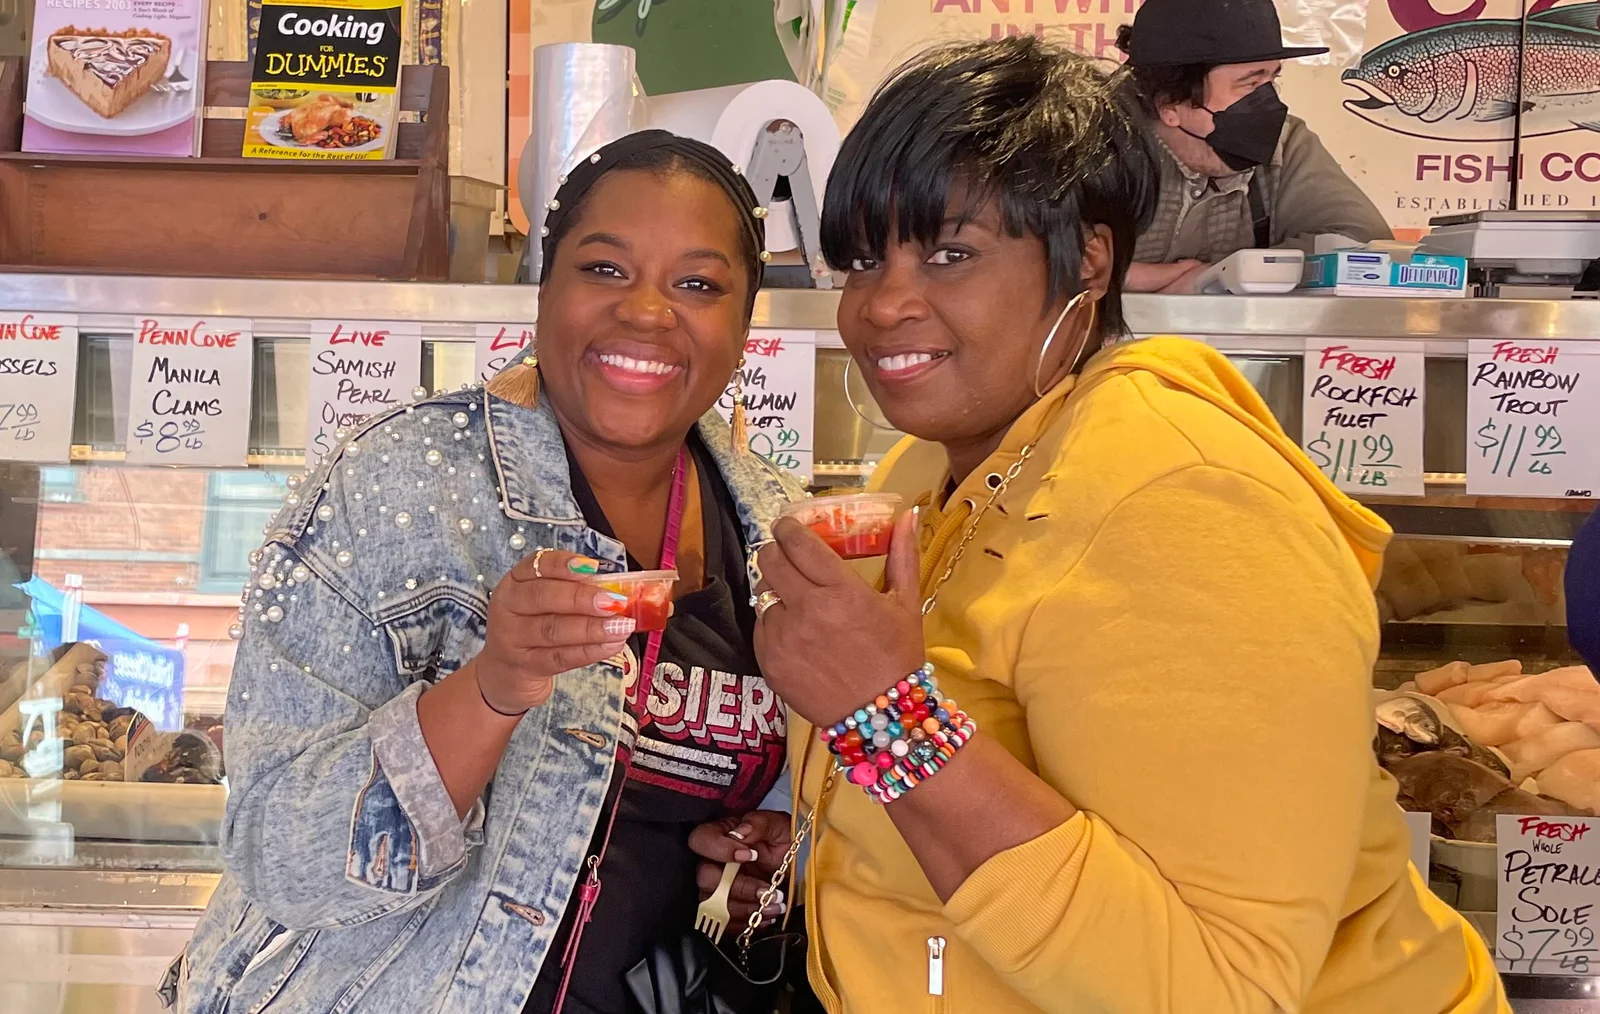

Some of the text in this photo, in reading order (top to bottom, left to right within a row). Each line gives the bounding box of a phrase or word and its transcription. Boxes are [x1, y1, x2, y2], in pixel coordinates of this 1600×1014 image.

[278, 13, 385, 45] Cooking
[319, 45, 334, 53] FOR
[265, 53, 386, 78] DUMMIES
[258, 148, 297, 157] Reference
[299, 150, 310, 158] for
[313, 151, 325, 159] the
[1416, 153, 1524, 183] FISH
[1396, 194, 1569, 211] ESTABLISHED
[20, 314, 64, 341] COVE
[138, 320, 241, 348] PENN COVE
[329, 324, 390, 347] LIVE
[490, 326, 534, 351] LI
[744, 338, 785, 358] ESH
[1491, 341, 1559, 365] FRESH
[0, 358, 58, 376] SSELS
[147, 356, 221, 386] MANILA
[312, 350, 397, 378] SAMISH
[1319, 345, 1396, 380] FRESH
[1472, 362, 1580, 393] RAINBOW
[152, 389, 222, 417] CLAMS
[337, 378, 399, 405] PEARL
[718, 386, 797, 412] SALMON
[1310, 374, 1418, 408] ROCKFISH
[1323, 406, 1388, 429] FILLET
[1490, 393, 1568, 417] TROUT
[1517, 816, 1591, 842] FRESH
[1532, 838, 1564, 854] WHOLE
[1511, 886, 1594, 925] SOLE
